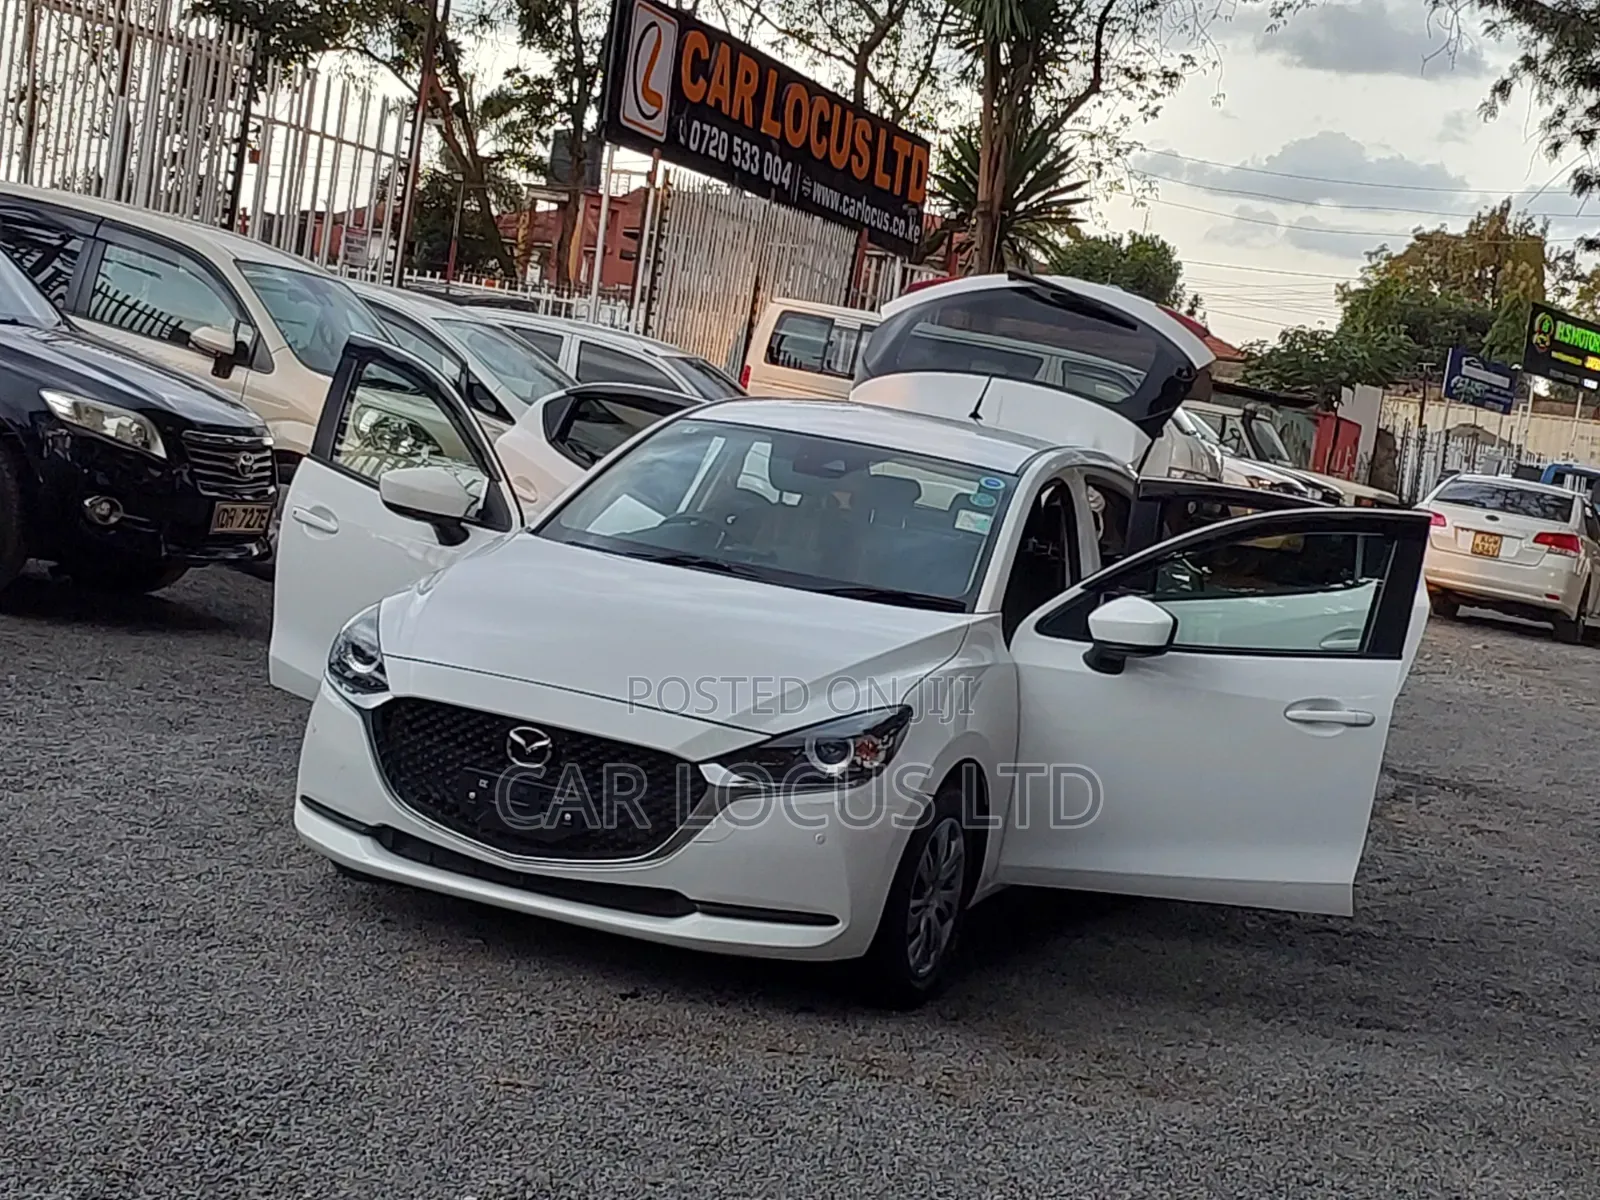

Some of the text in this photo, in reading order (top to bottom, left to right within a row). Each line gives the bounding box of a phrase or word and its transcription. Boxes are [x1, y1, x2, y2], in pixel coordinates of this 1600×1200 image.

[681, 30, 928, 204] CAR LOCUS LTD
[689, 120, 793, 191] 0720 533 004
[812, 181, 920, 244] www.carlocus.co.ke
